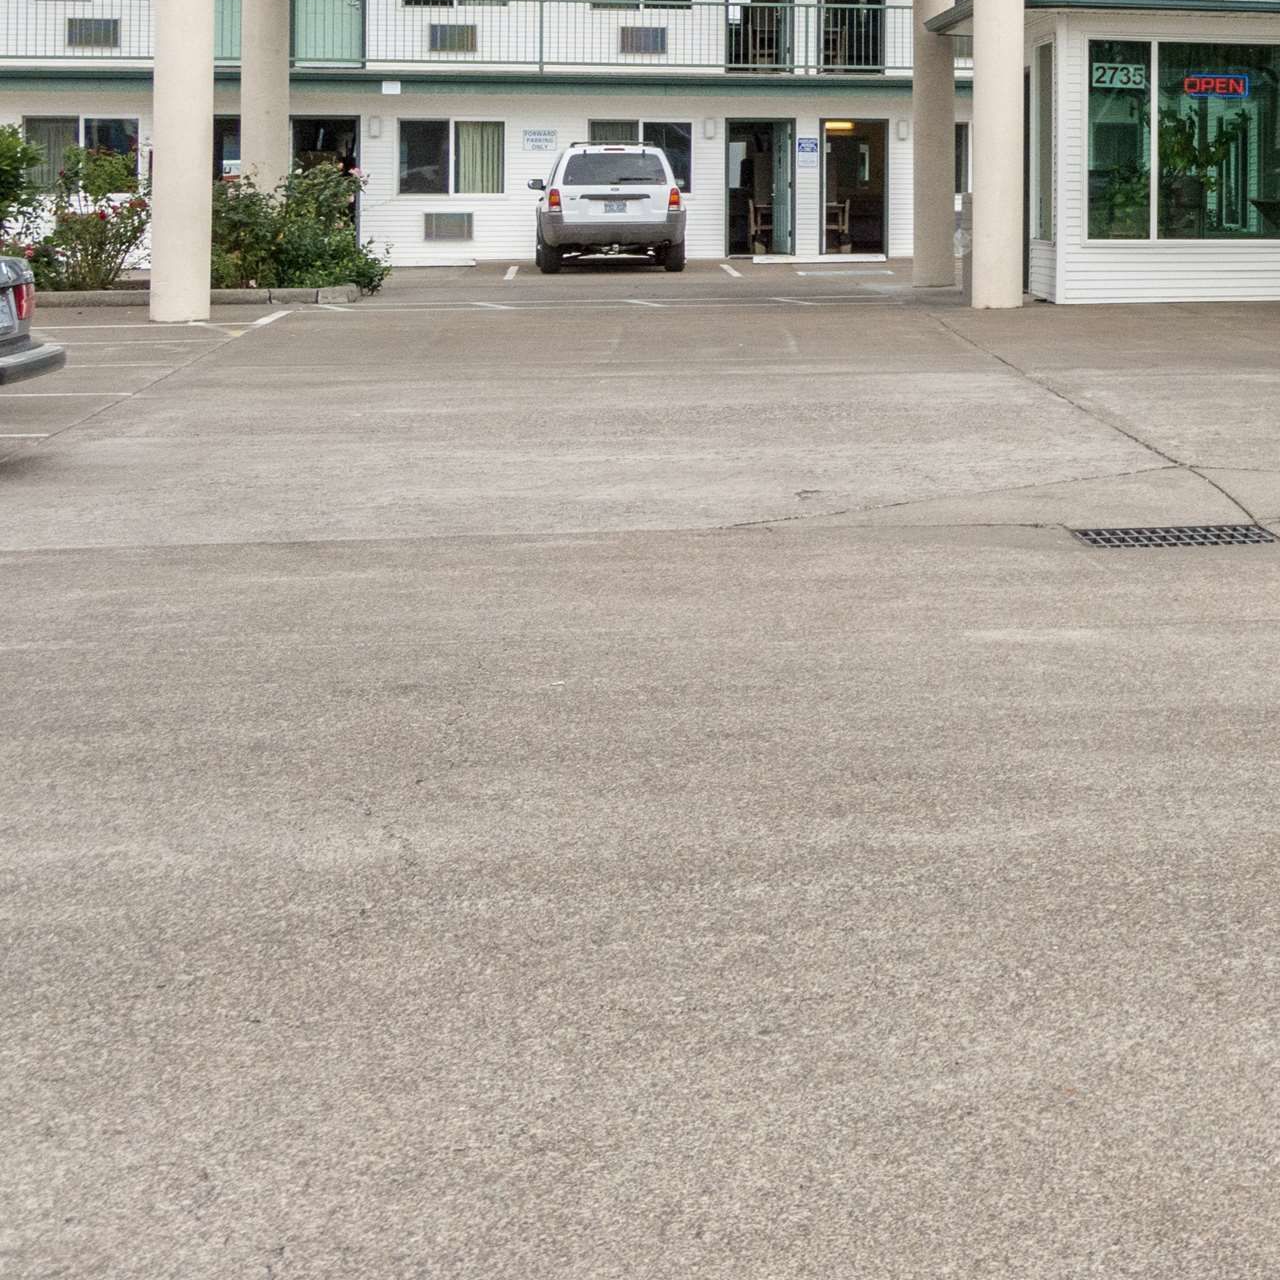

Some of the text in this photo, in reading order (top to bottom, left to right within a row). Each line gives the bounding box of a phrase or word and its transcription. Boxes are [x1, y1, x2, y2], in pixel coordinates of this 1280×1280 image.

[1094, 66, 1144, 86] 2735
[1183, 76, 1245, 94] OPEN
[531, 143, 549, 151] ONLY
